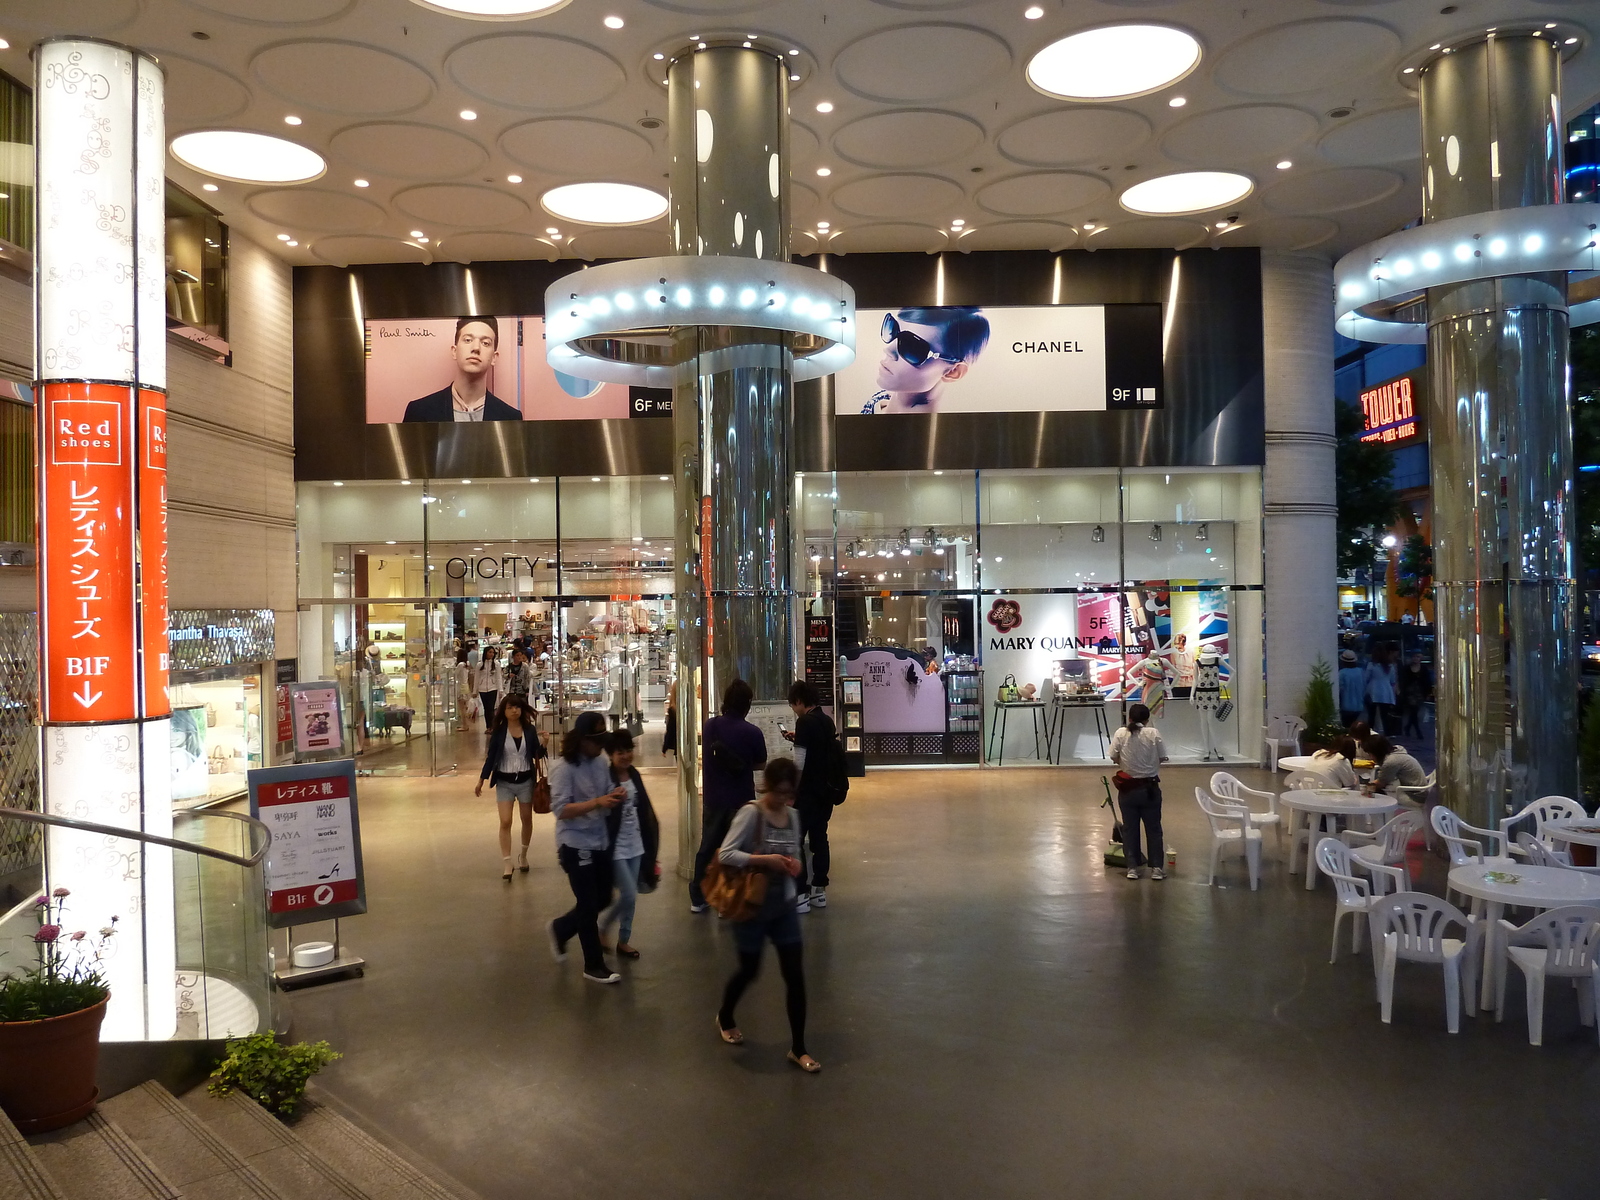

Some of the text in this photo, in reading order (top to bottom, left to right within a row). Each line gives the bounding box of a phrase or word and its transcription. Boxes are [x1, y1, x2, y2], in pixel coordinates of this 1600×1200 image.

[379, 326, 436, 338] Paul Smith
[1012, 340, 1084, 354] CHANEL
[1112, 387, 1131, 401] 9F
[634, 398, 673, 412] 6F ME
[1360, 377, 1413, 431] TOWER
[60, 418, 111, 436] Red
[61, 437, 111, 448] shoes
[446, 557, 540, 579] OICITY
[1089, 617, 1108, 630] 5F
[207, 624, 244, 639] Thavasa
[809, 624, 829, 638] 50
[990, 636, 1096, 653] MARY QUANT
[1101, 646, 1121, 654] MARY
[66, 656, 110, 676] B1F
[869, 665, 886, 674] ANNA
[872, 674, 883, 683] SUI
[274, 830, 301, 841] SAYA
[317, 829, 338, 837] works
[287, 893, 307, 906] B1F
